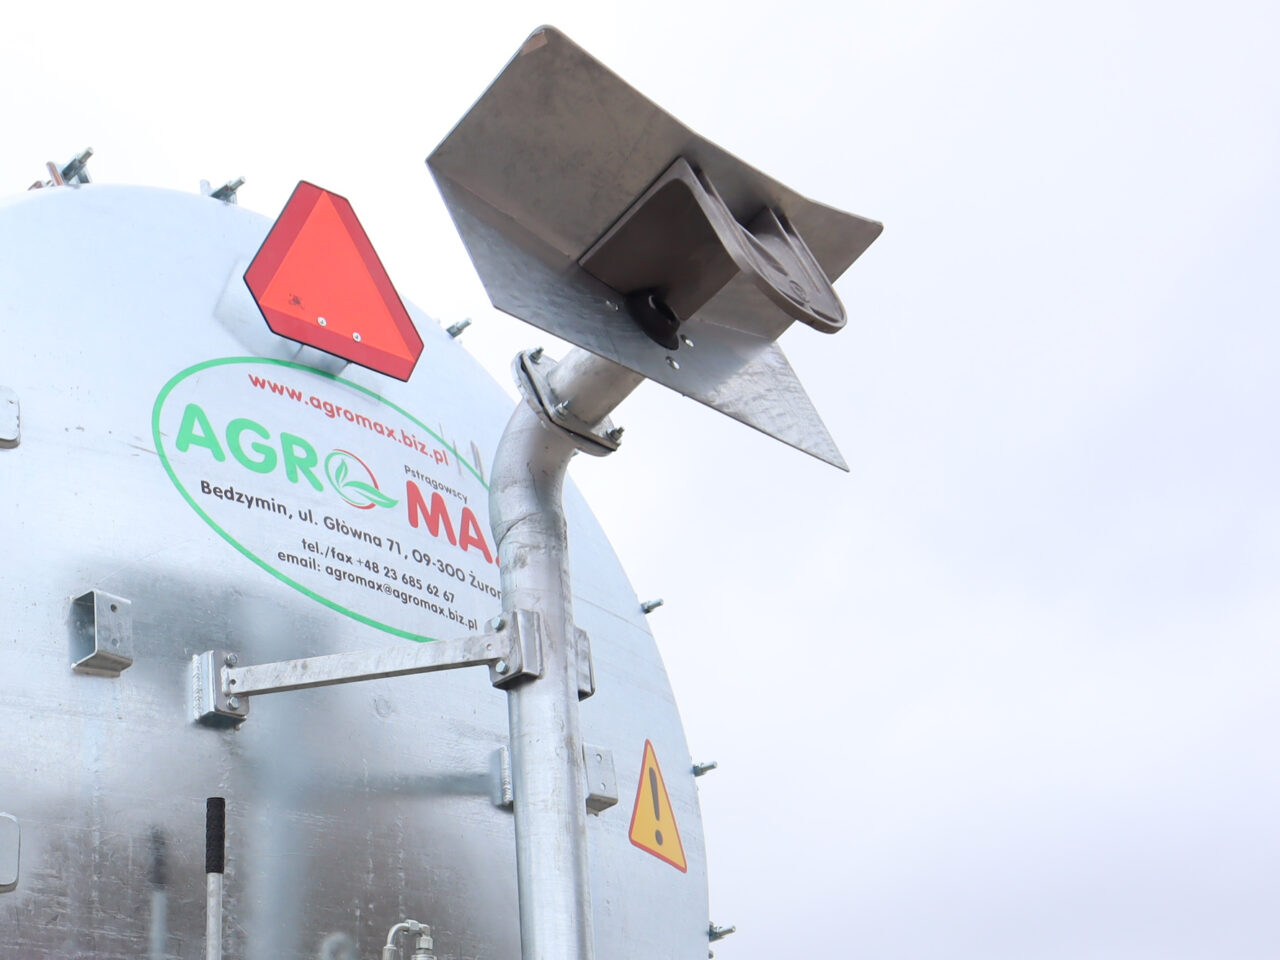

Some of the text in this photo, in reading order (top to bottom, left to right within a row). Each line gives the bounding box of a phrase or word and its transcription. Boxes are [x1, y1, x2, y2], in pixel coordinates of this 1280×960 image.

[248, 374, 449, 466] www.agromax.biz.pl
[298, 509, 318, 526] ul.
[412, 549, 466, 582] 09-300
[406, 480, 500, 568] MA
[277, 551, 478, 630] email: agromax@agromax.biz.pl
[301, 538, 455, 603] tel./fax +48 23 685 62 67
